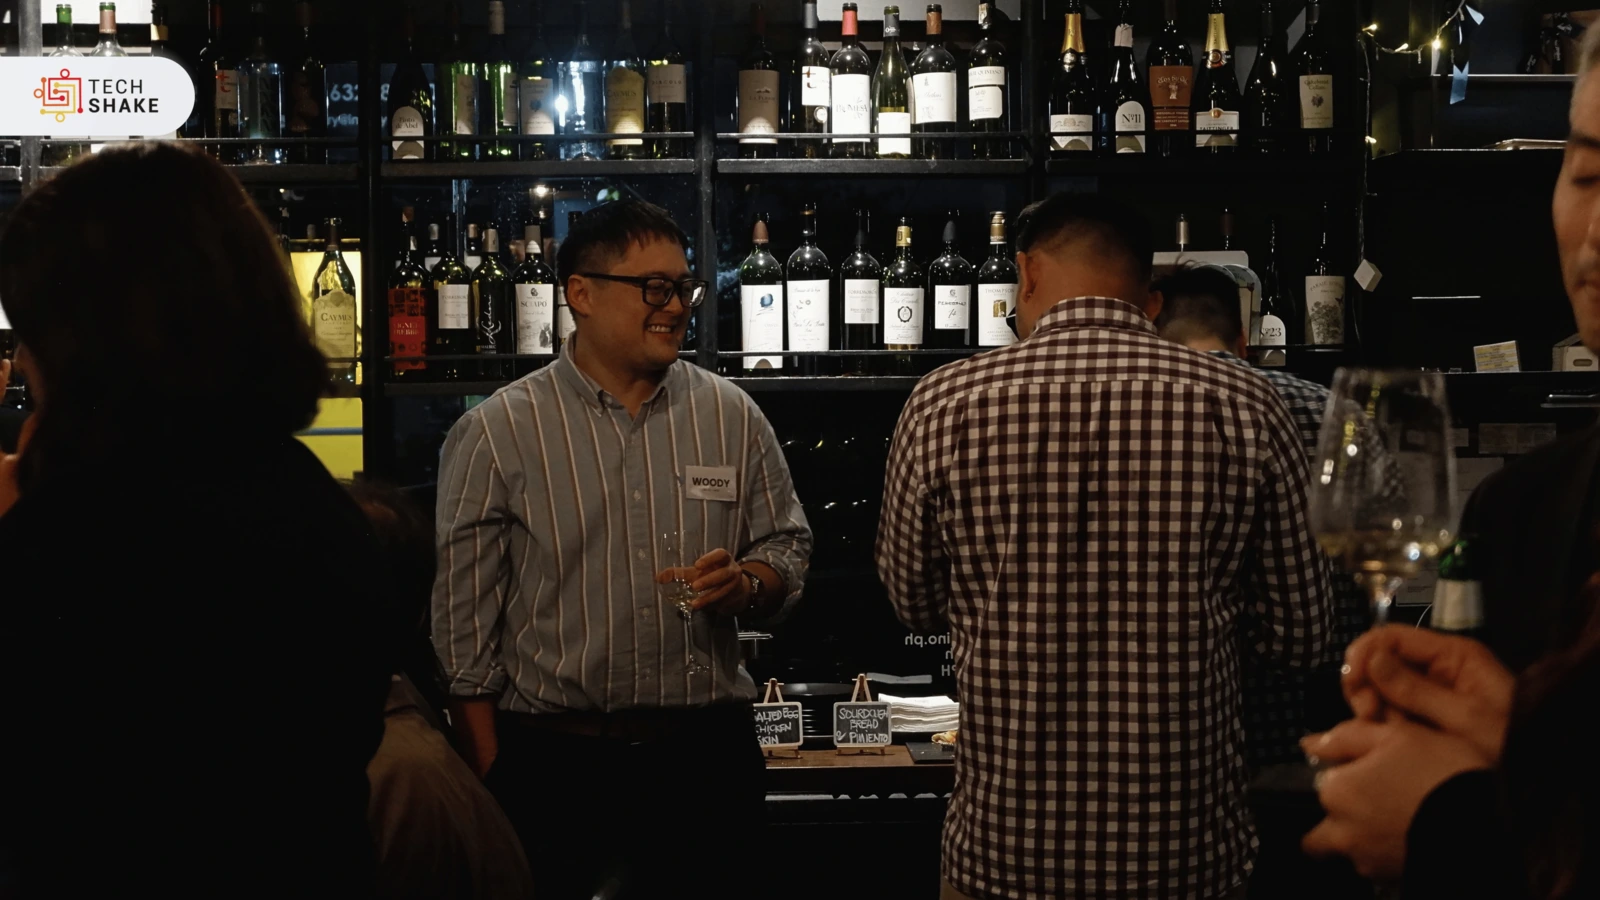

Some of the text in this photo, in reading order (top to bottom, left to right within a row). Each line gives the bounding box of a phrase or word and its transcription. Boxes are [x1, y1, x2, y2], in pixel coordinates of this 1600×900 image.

[321, 312, 352, 322] CAYMUS
[692, 477, 730, 488] WOODY
[753, 707, 799, 723] ALTED EGG
[838, 706, 889, 720] SOURDOUGH
[850, 718, 879, 730] BREAD
[757, 733, 779, 745] SKIN
[849, 729, 888, 745] PIMIENTO
